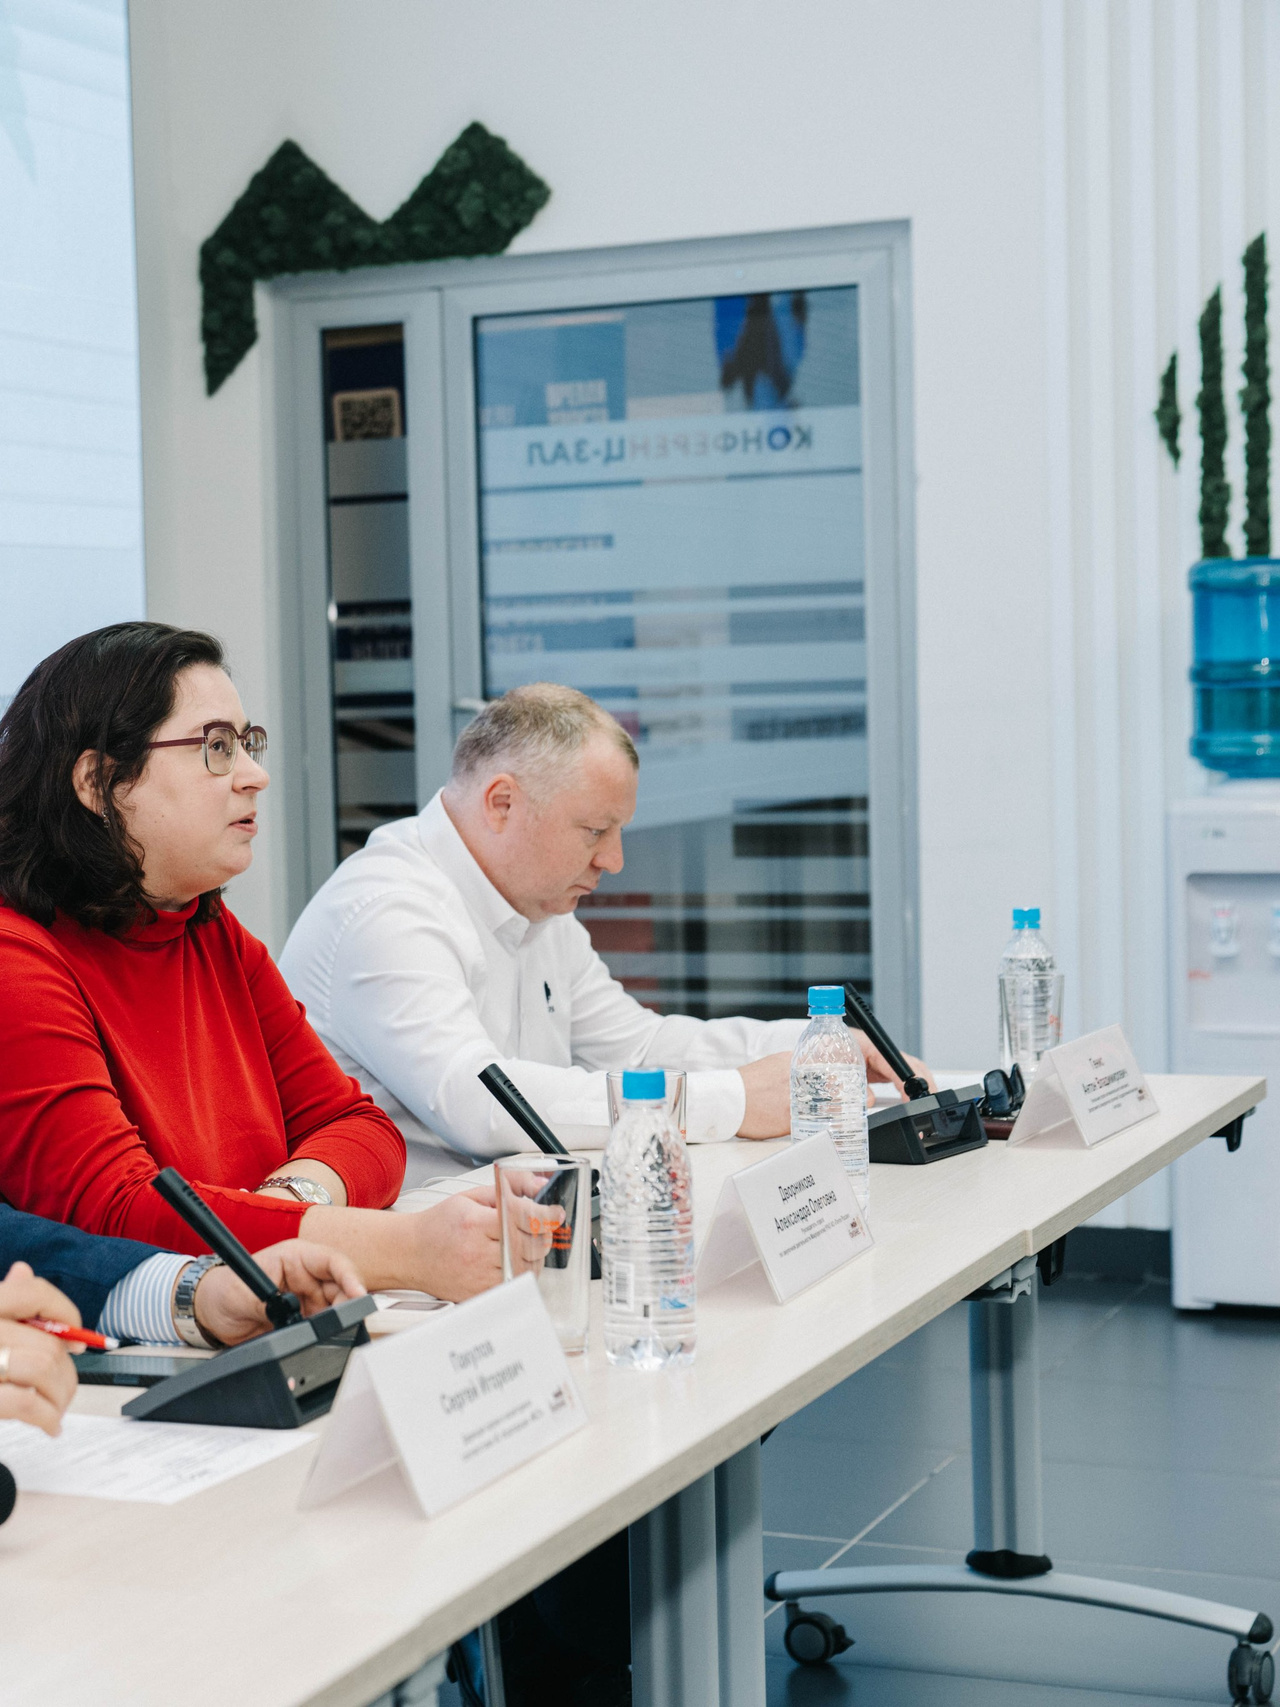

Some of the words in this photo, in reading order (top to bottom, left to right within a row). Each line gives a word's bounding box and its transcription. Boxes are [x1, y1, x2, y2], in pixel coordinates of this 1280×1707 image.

[778, 1174, 816, 1204] Дворникова
[774, 1204, 812, 1234] Александра
[807, 1190, 838, 1214] Олеговна
